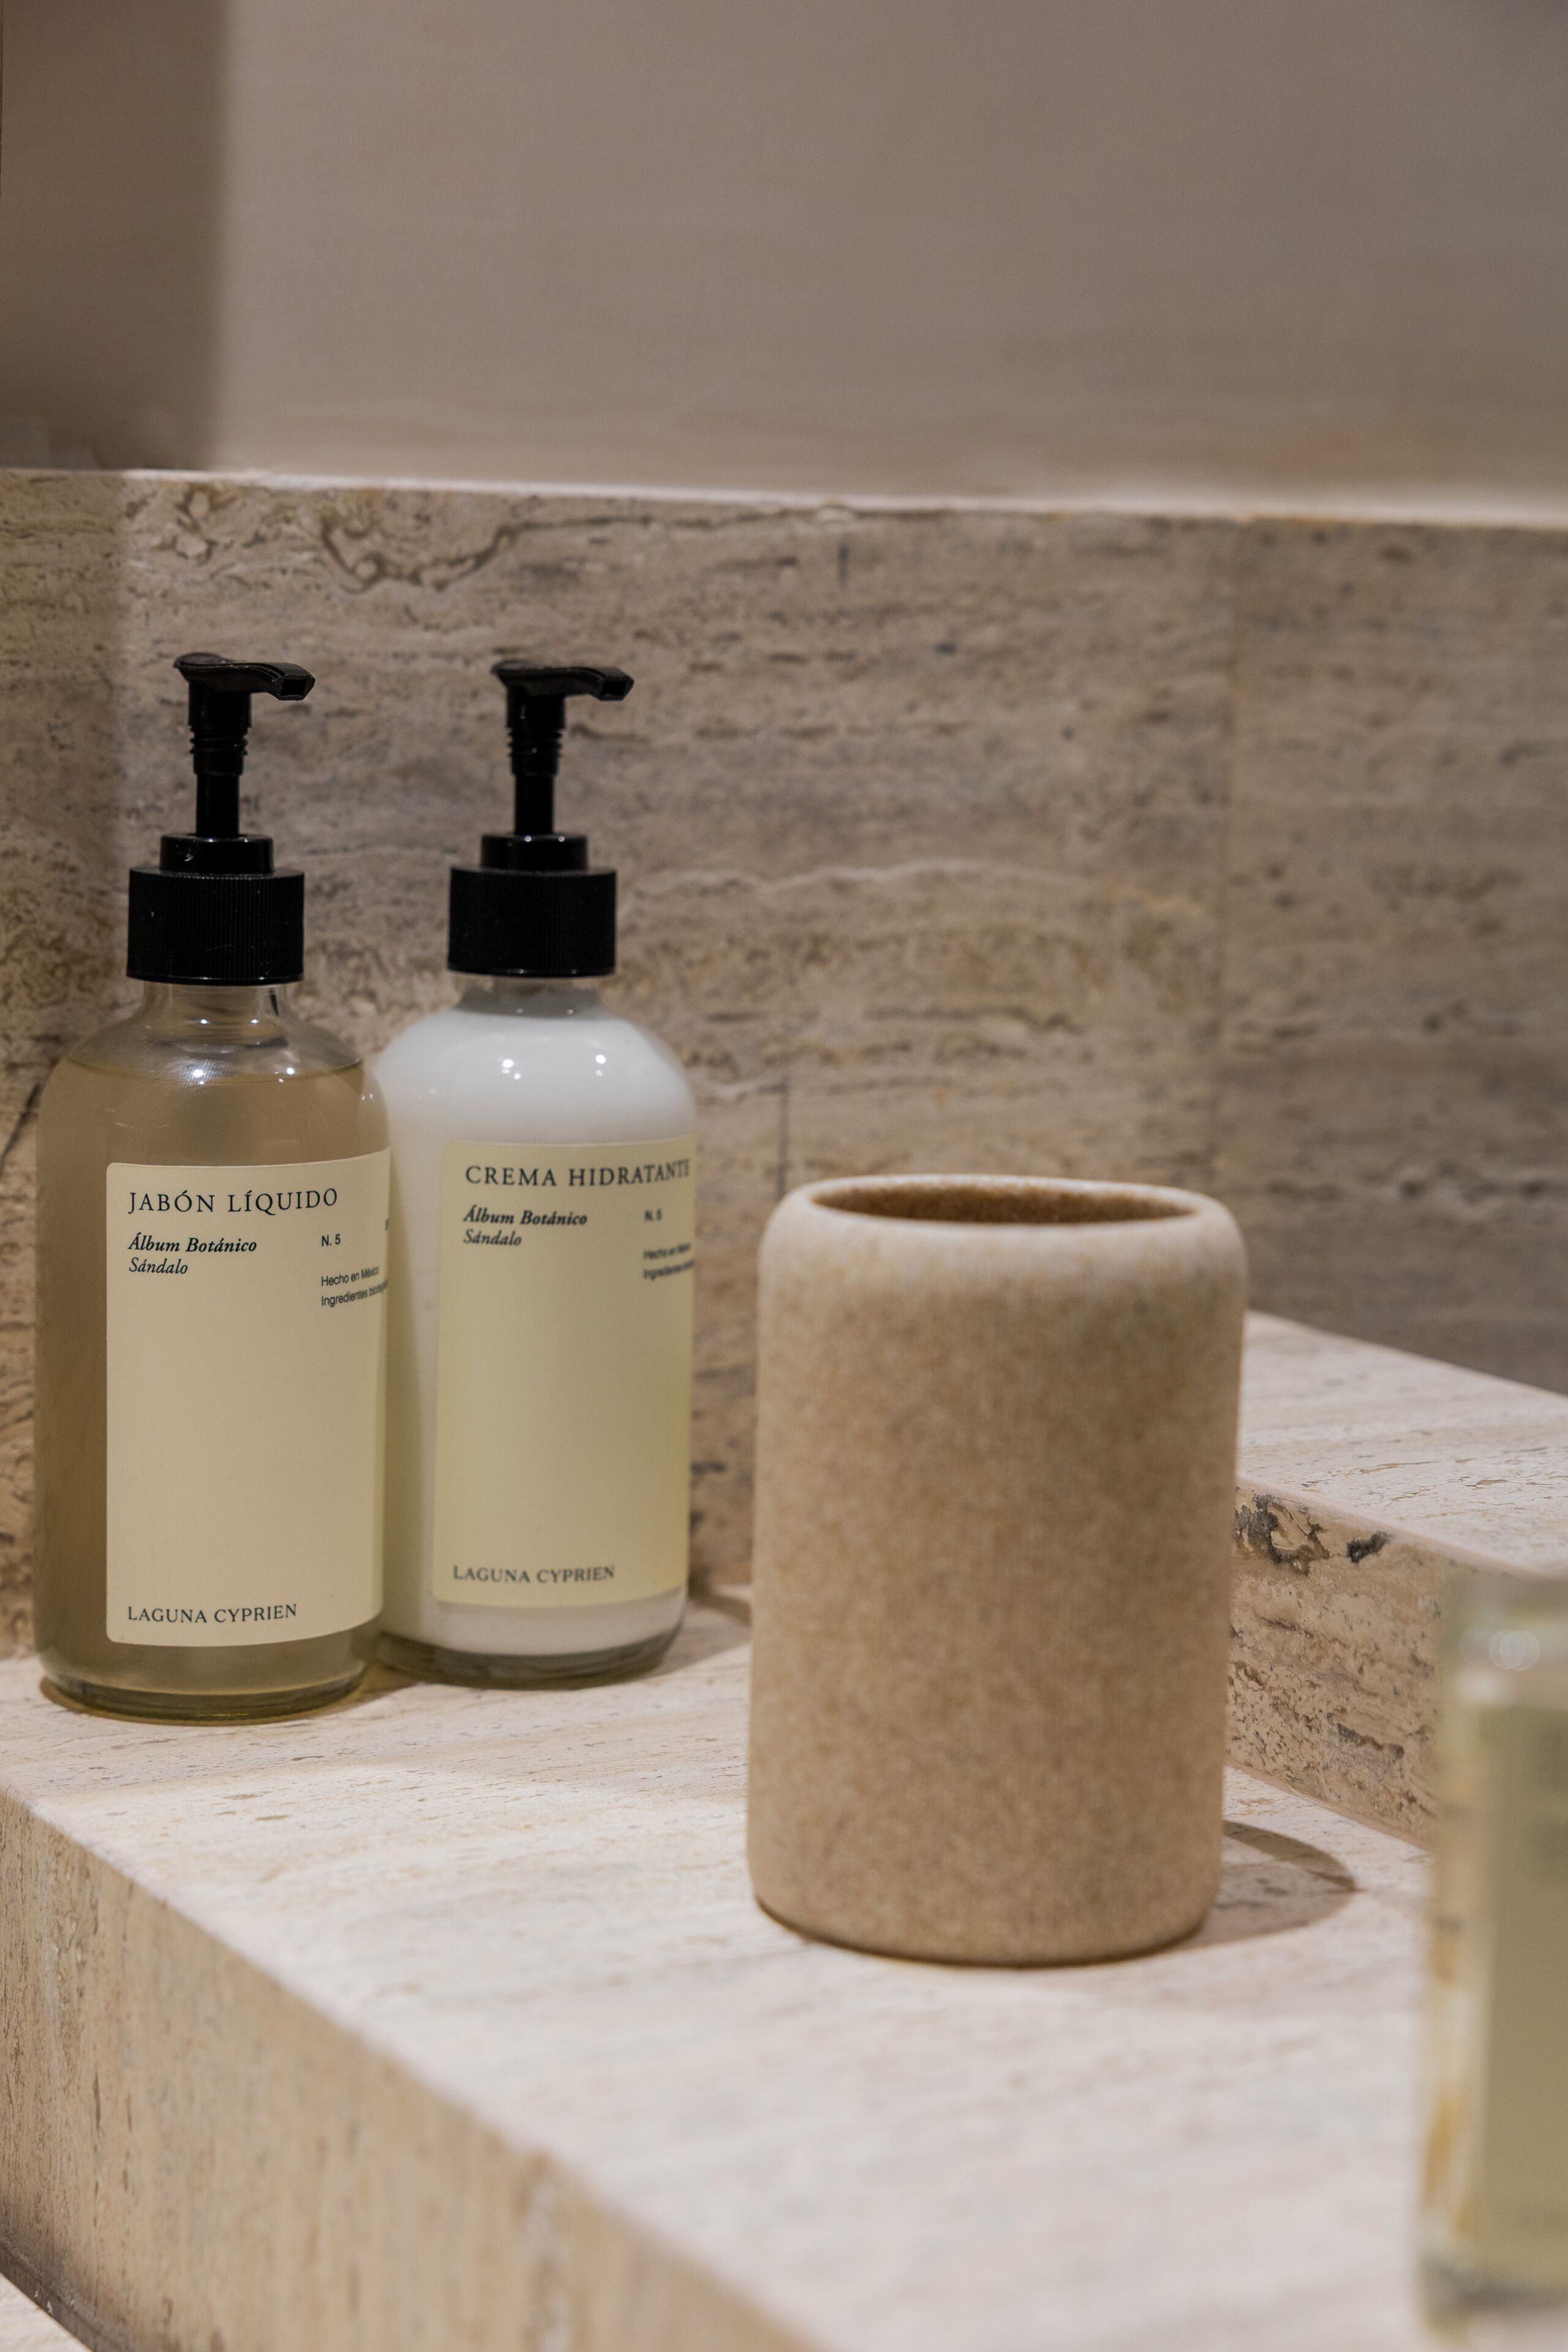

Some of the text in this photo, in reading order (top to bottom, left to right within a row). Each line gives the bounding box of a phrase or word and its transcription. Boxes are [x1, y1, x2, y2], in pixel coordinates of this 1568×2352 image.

[465, 1166, 557, 1187] CREMA
[127, 1188, 337, 1216] JABÓN LÍQUIDO
[462, 1204, 588, 1226] Álbum Botánico
[127, 1231, 257, 1253] Álbum Botánico
[321, 1233, 341, 1247] N. 5
[463, 1228, 522, 1246] Sándalo
[129, 1257, 189, 1275] Sándalo
[321, 1273, 350, 1287] Hecho
[350, 1272, 360, 1283] en
[321, 1289, 369, 1308] Ingredientes
[453, 1565, 615, 1584] LAGUNA CYPRIEN
[128, 1603, 296, 1623] LAGUNA CYPRIEN
